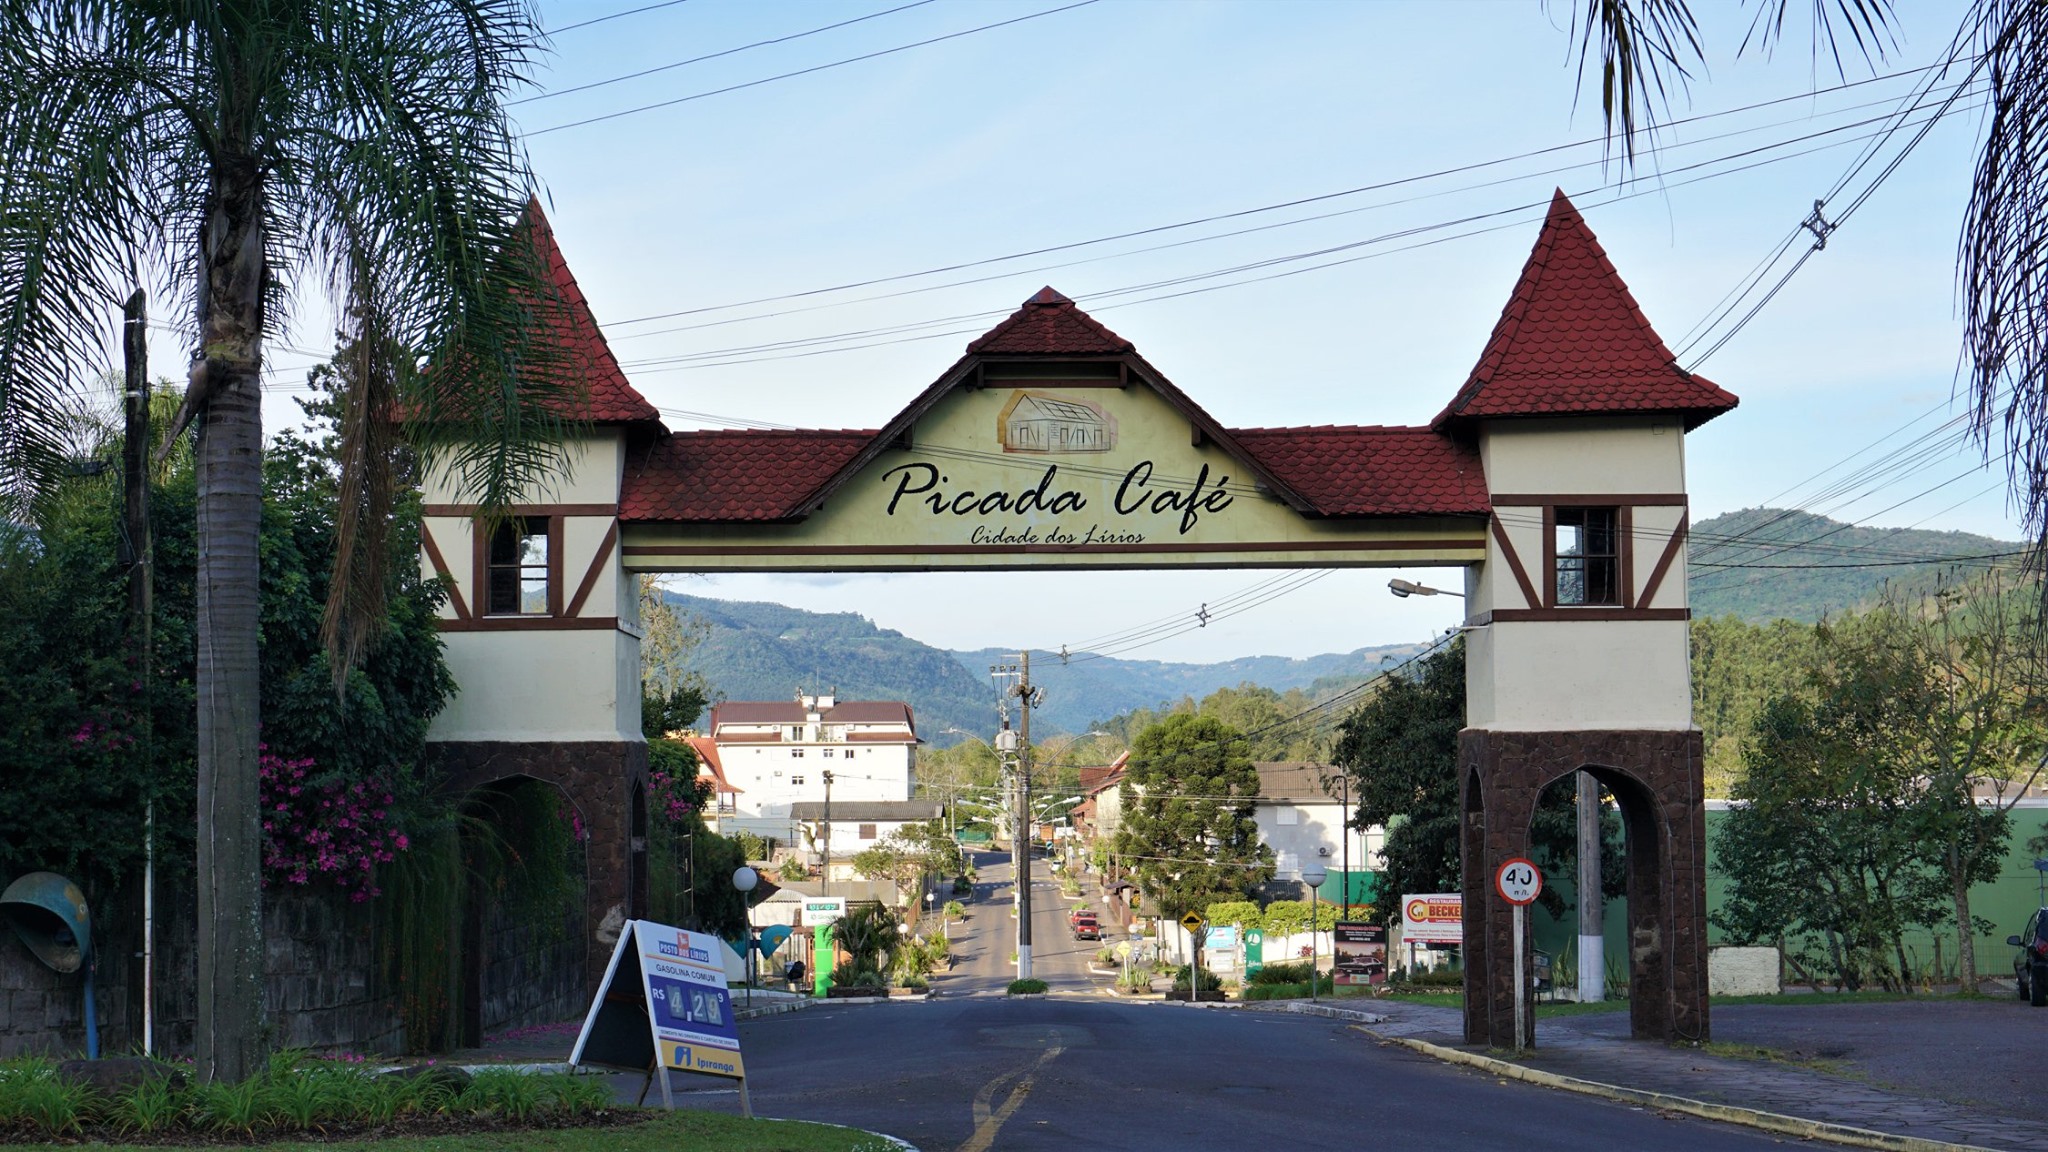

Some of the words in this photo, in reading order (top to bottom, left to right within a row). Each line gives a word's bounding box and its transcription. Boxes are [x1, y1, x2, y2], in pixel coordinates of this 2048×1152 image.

[881, 463, 1087, 516] Picada
[1114, 460, 1234, 535] Café
[971, 525, 1040, 545] Cidade
[1044, 525, 1078, 545] dos
[1081, 523, 1146, 546] Lírios
[1428, 905, 1462, 917] BECKE
[660, 943, 678, 955] POSTO
[656, 963, 690, 977] GASOLINA
[691, 971, 717, 983] COMUM
[652, 988, 665, 1000] R$
[697, 1057, 734, 1073] Ipiranga
